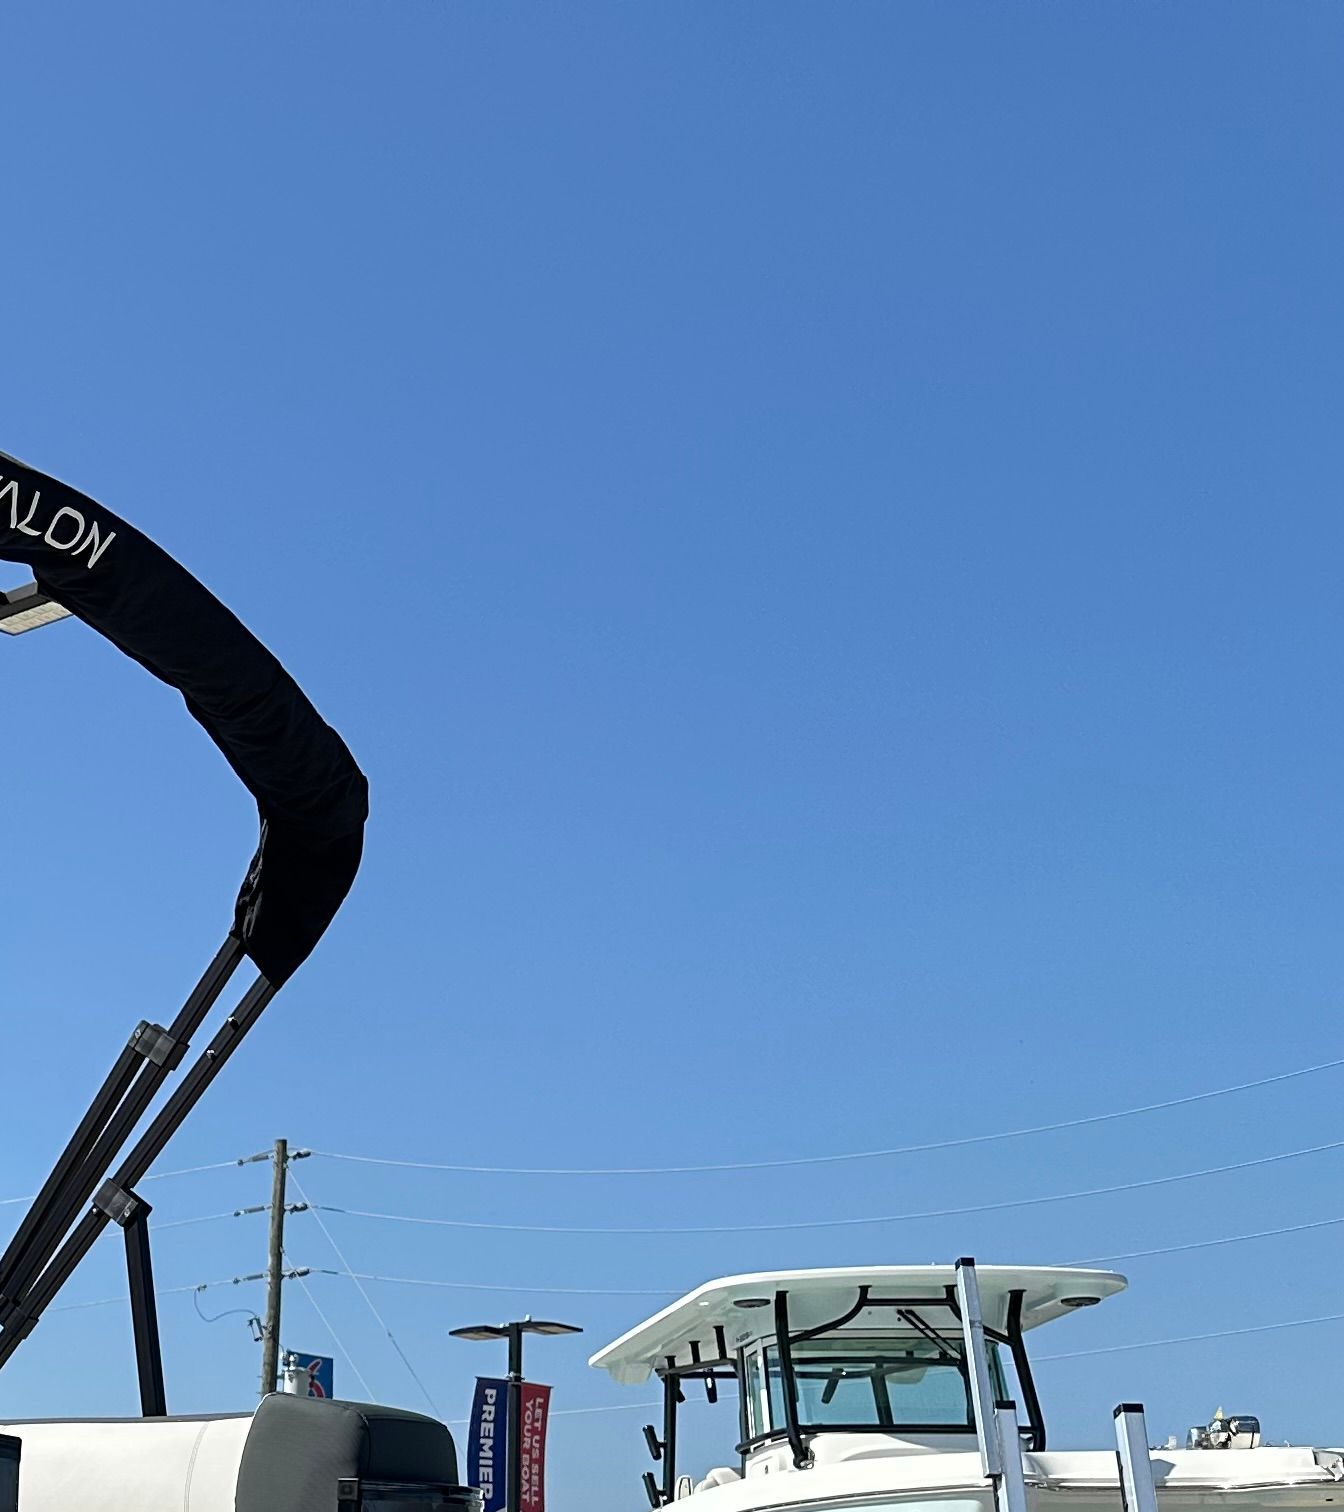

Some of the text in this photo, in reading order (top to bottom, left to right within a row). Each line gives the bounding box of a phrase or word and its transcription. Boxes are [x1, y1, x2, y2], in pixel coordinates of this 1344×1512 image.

[521, 1398, 534, 1503] YOUR BOAT
[531, 1397, 544, 1506] LET US SELL
